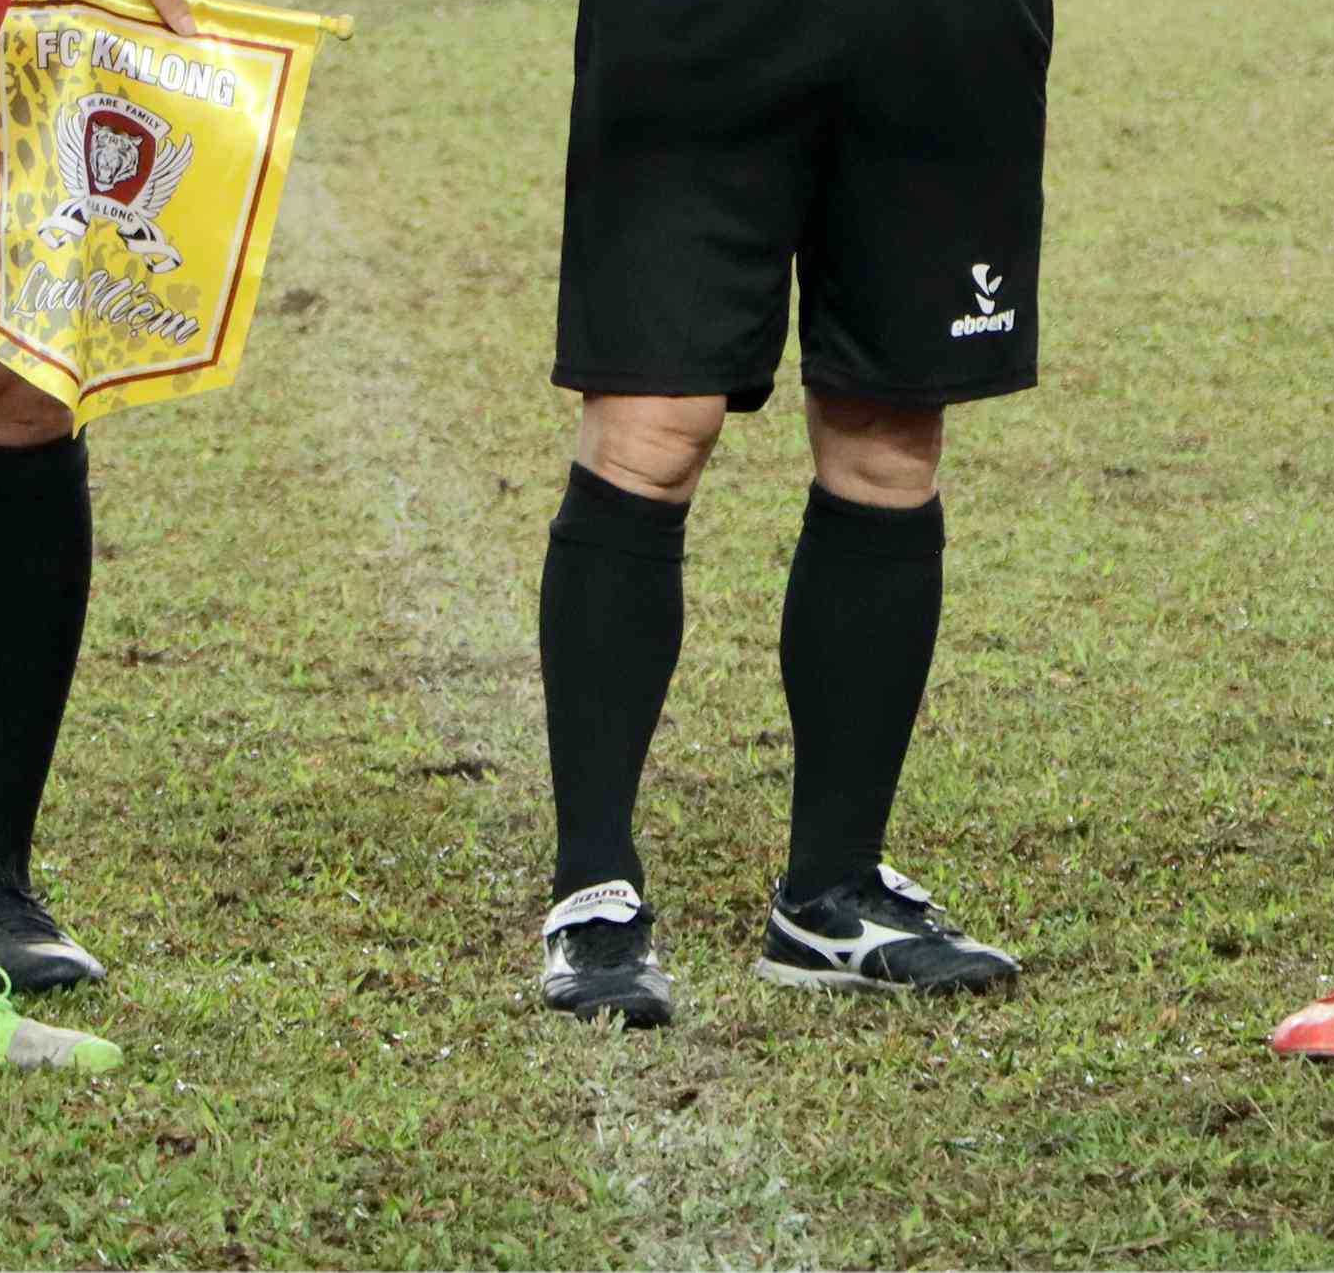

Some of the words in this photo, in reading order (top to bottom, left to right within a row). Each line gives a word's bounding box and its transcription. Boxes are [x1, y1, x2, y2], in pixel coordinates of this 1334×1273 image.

[36, 29, 83, 69] FC
[90, 29, 236, 107] KALONG
[98, 97, 119, 108] ARE
[125, 104, 160, 129] FAMILY
